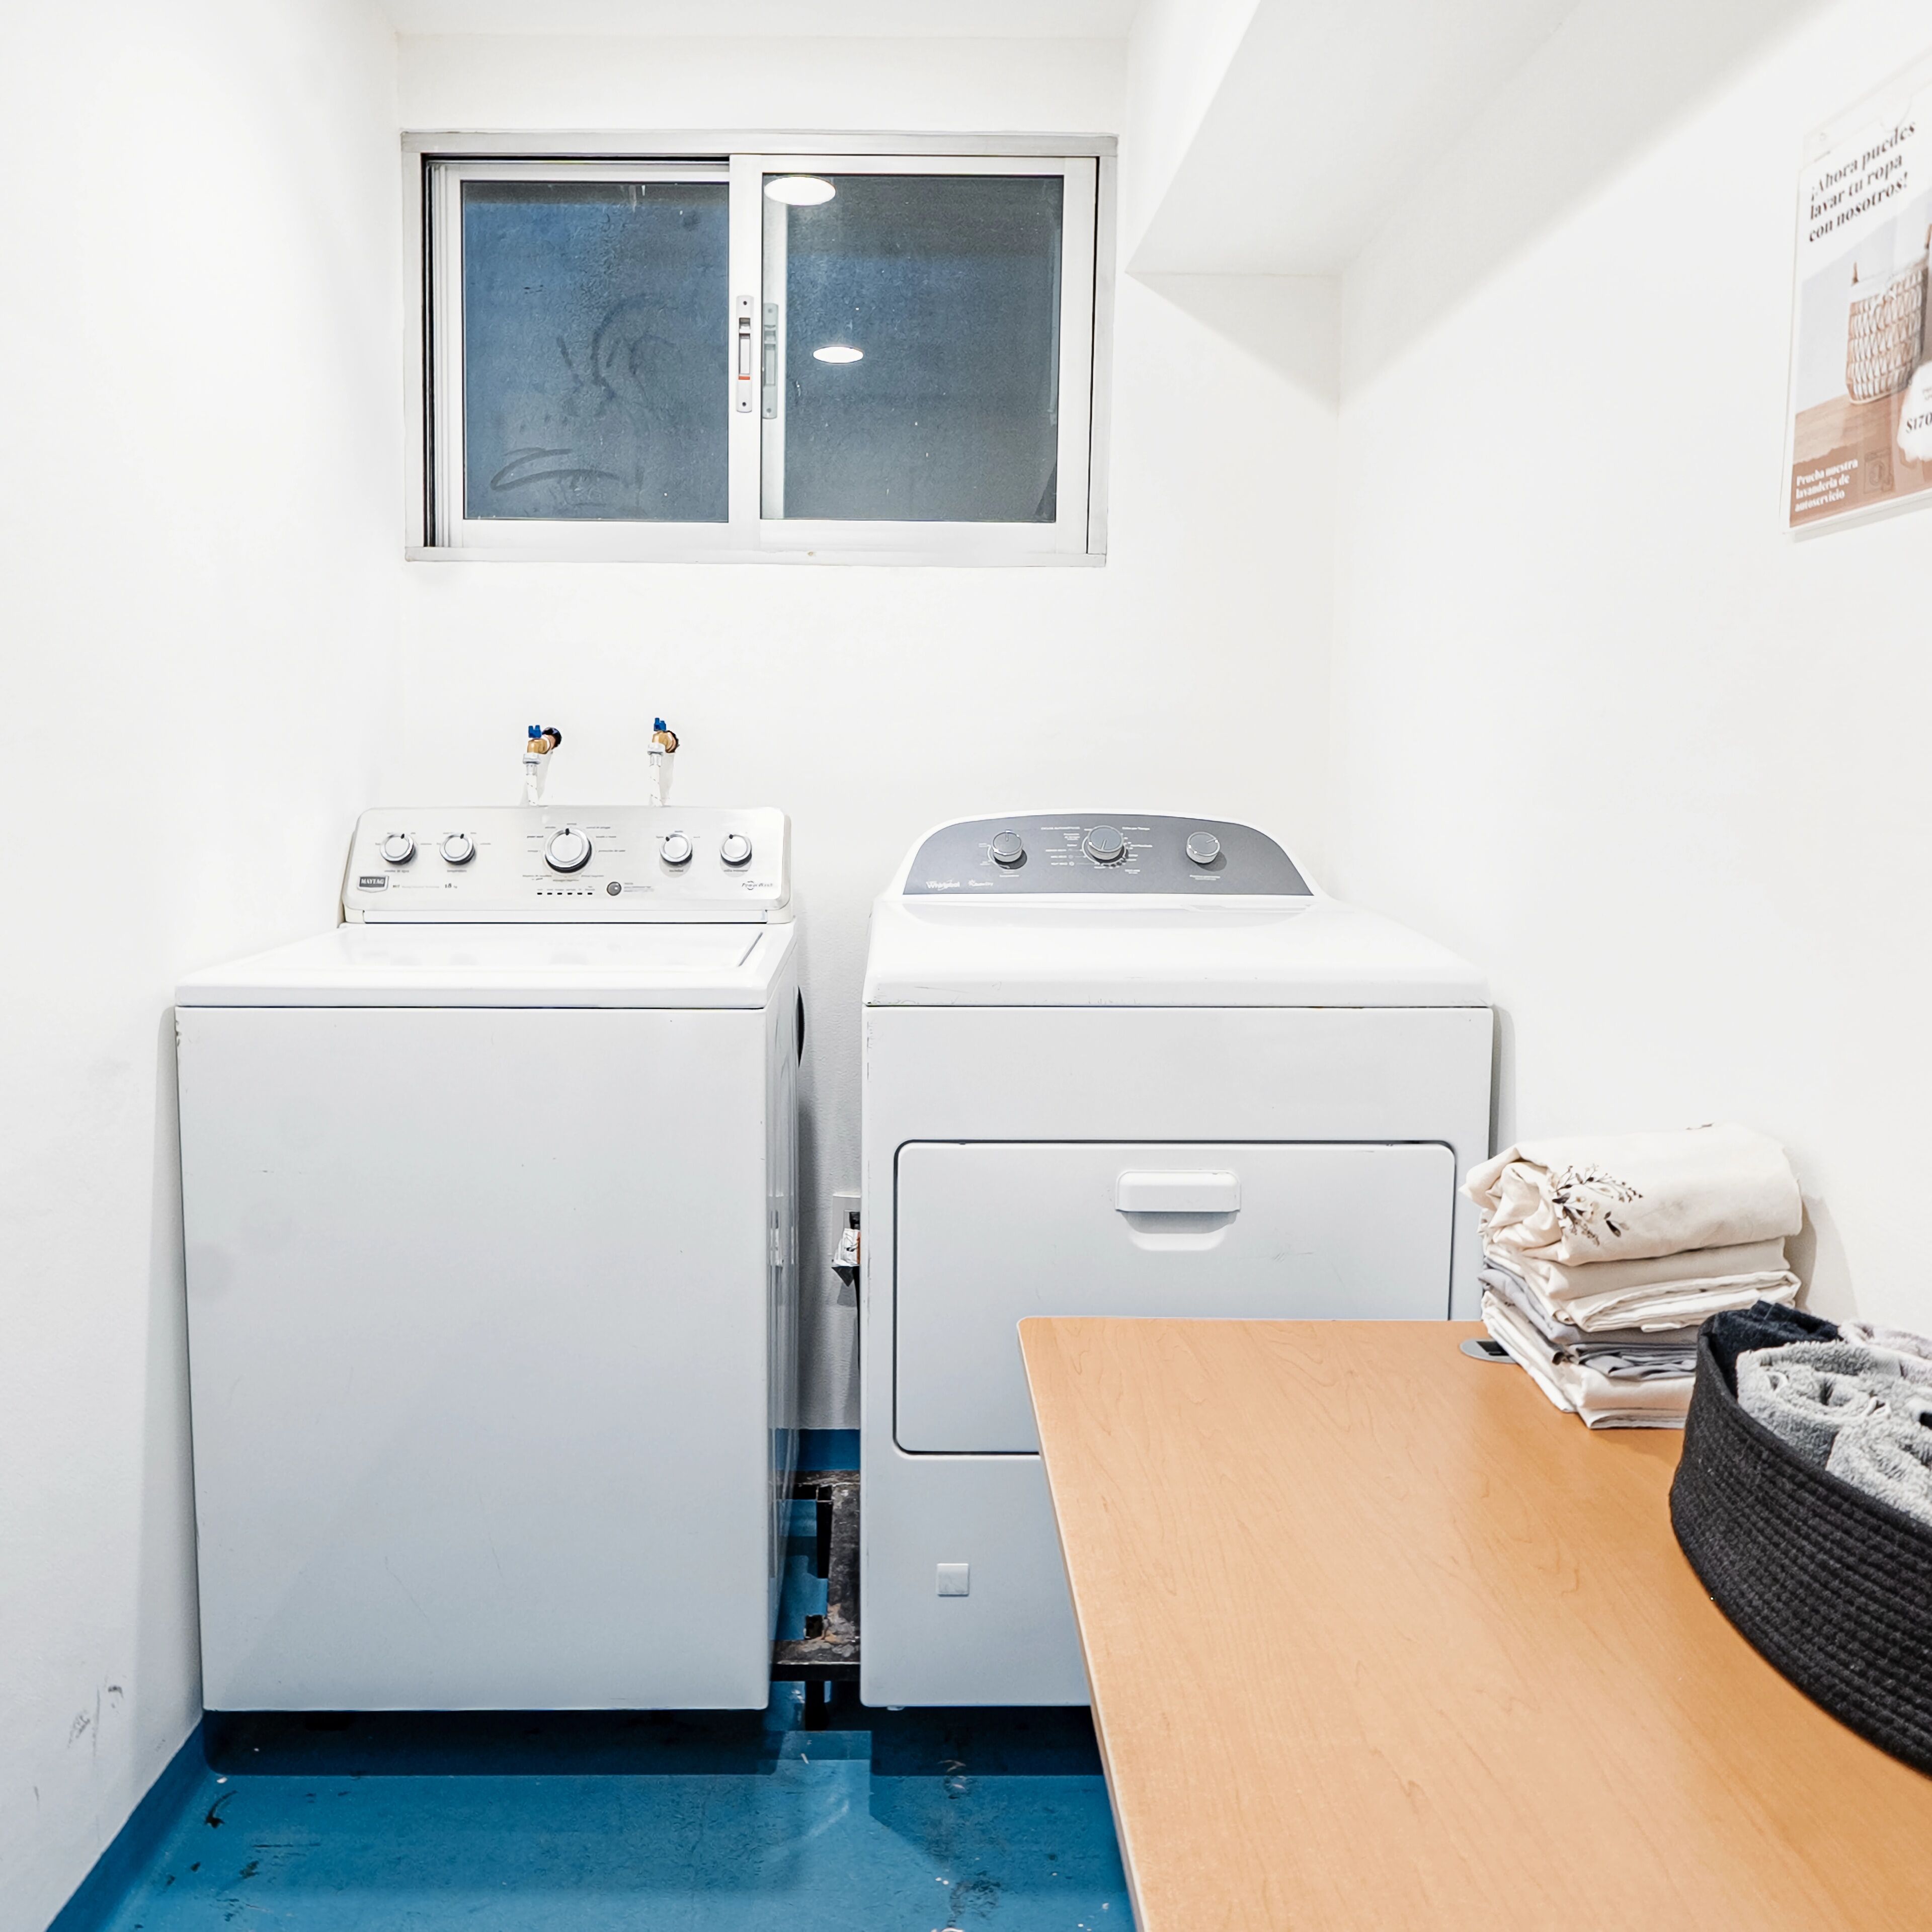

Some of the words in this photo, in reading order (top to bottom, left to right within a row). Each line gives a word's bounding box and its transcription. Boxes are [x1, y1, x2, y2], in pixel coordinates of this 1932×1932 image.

[1862, 122, 1915, 171] puedes
[1809, 219, 1832, 242] con
[1837, 172, 1908, 226] nosotros!
[1811, 190, 1845, 220] lavar
[1849, 179, 1863, 197] tu
[1867, 154, 1902, 185] ropa
[1838, 473, 1850, 486] de
